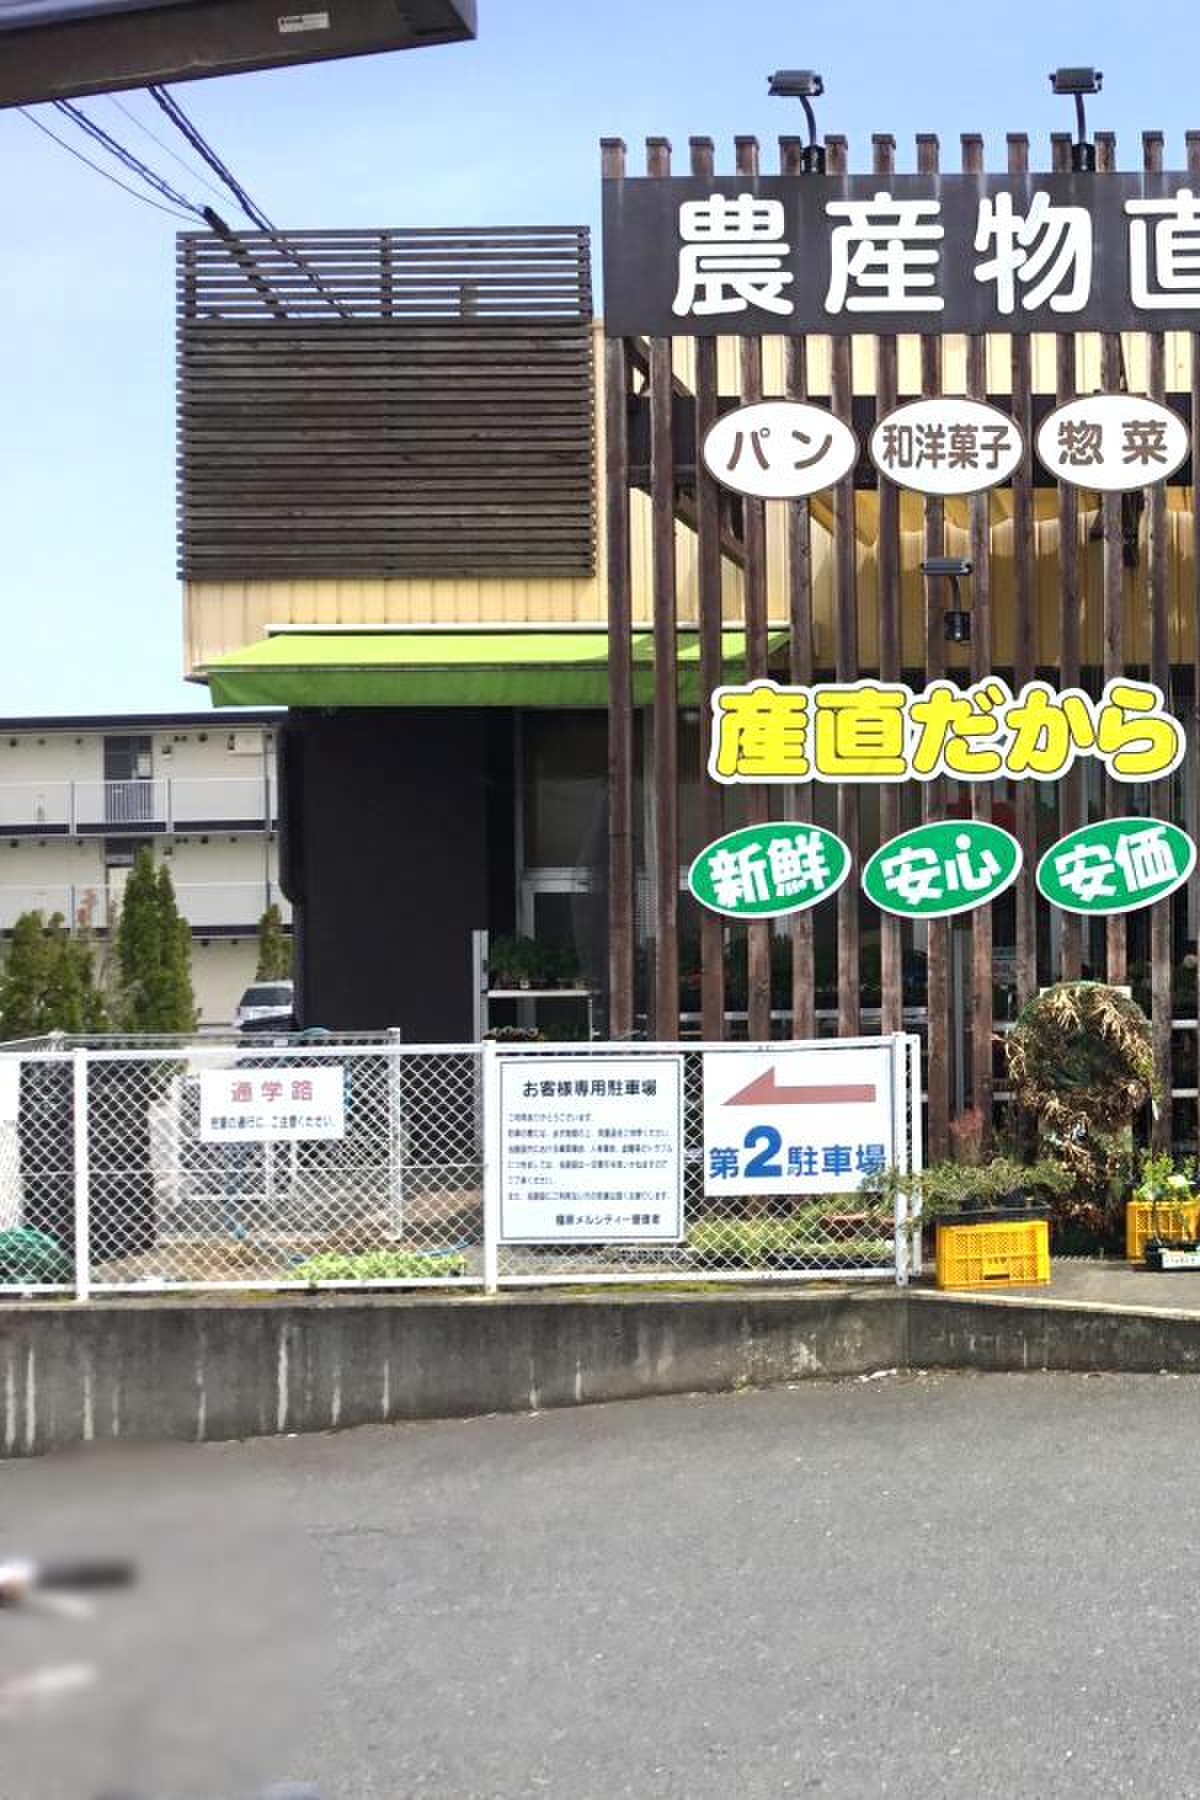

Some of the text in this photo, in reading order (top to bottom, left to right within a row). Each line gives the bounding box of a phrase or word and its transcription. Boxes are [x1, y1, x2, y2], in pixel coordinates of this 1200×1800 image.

[727, 427, 833, 471] パン
[881, 419, 1014, 471] 和洋菓子
[1057, 418, 1169, 468] 惣菜
[716, 684, 1179, 777] 産直だから
[707, 830, 831, 908] 新鮮
[880, 833, 1001, 905] 安心
[1056, 826, 1179, 903] 安価
[231, 1079, 314, 1103] 通学路
[523, 1079, 657, 1098] お客様専用駐車場
[709, 1125, 887, 1180] 第2駐車場
